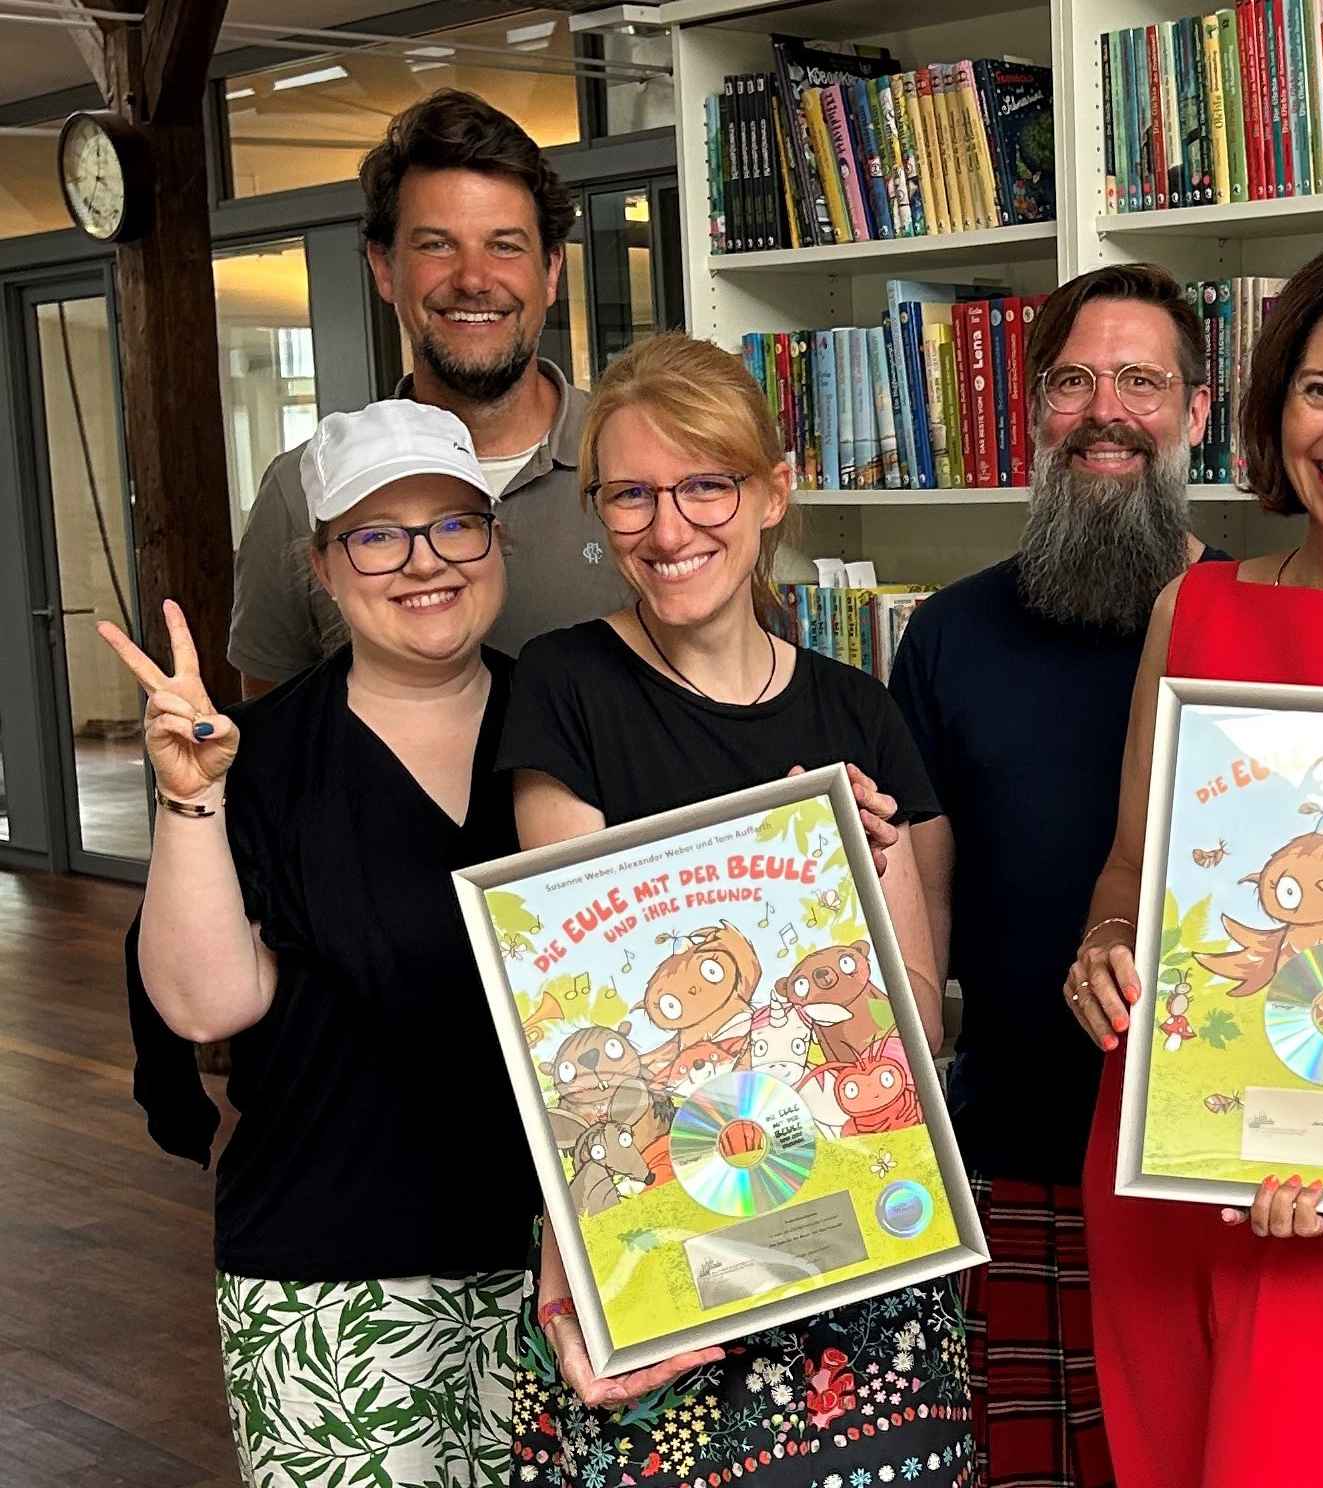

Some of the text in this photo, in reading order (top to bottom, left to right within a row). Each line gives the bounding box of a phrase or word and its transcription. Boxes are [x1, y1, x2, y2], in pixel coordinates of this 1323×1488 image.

[972, 330, 983, 368] Lena
[545, 877, 583, 892] Susanne
[584, 866, 617, 883] Weber,
[618, 854, 664, 872] Alexander
[665, 844, 694, 859] Weber
[695, 839, 713, 851] und
[714, 832, 733, 844] Tom
[561, 887, 629, 945] EULE
[678, 864, 720, 886] DER
[726, 854, 818, 885] BEULE
[603, 915, 638, 944] UND
[685, 887, 762, 908] FREUNDE
